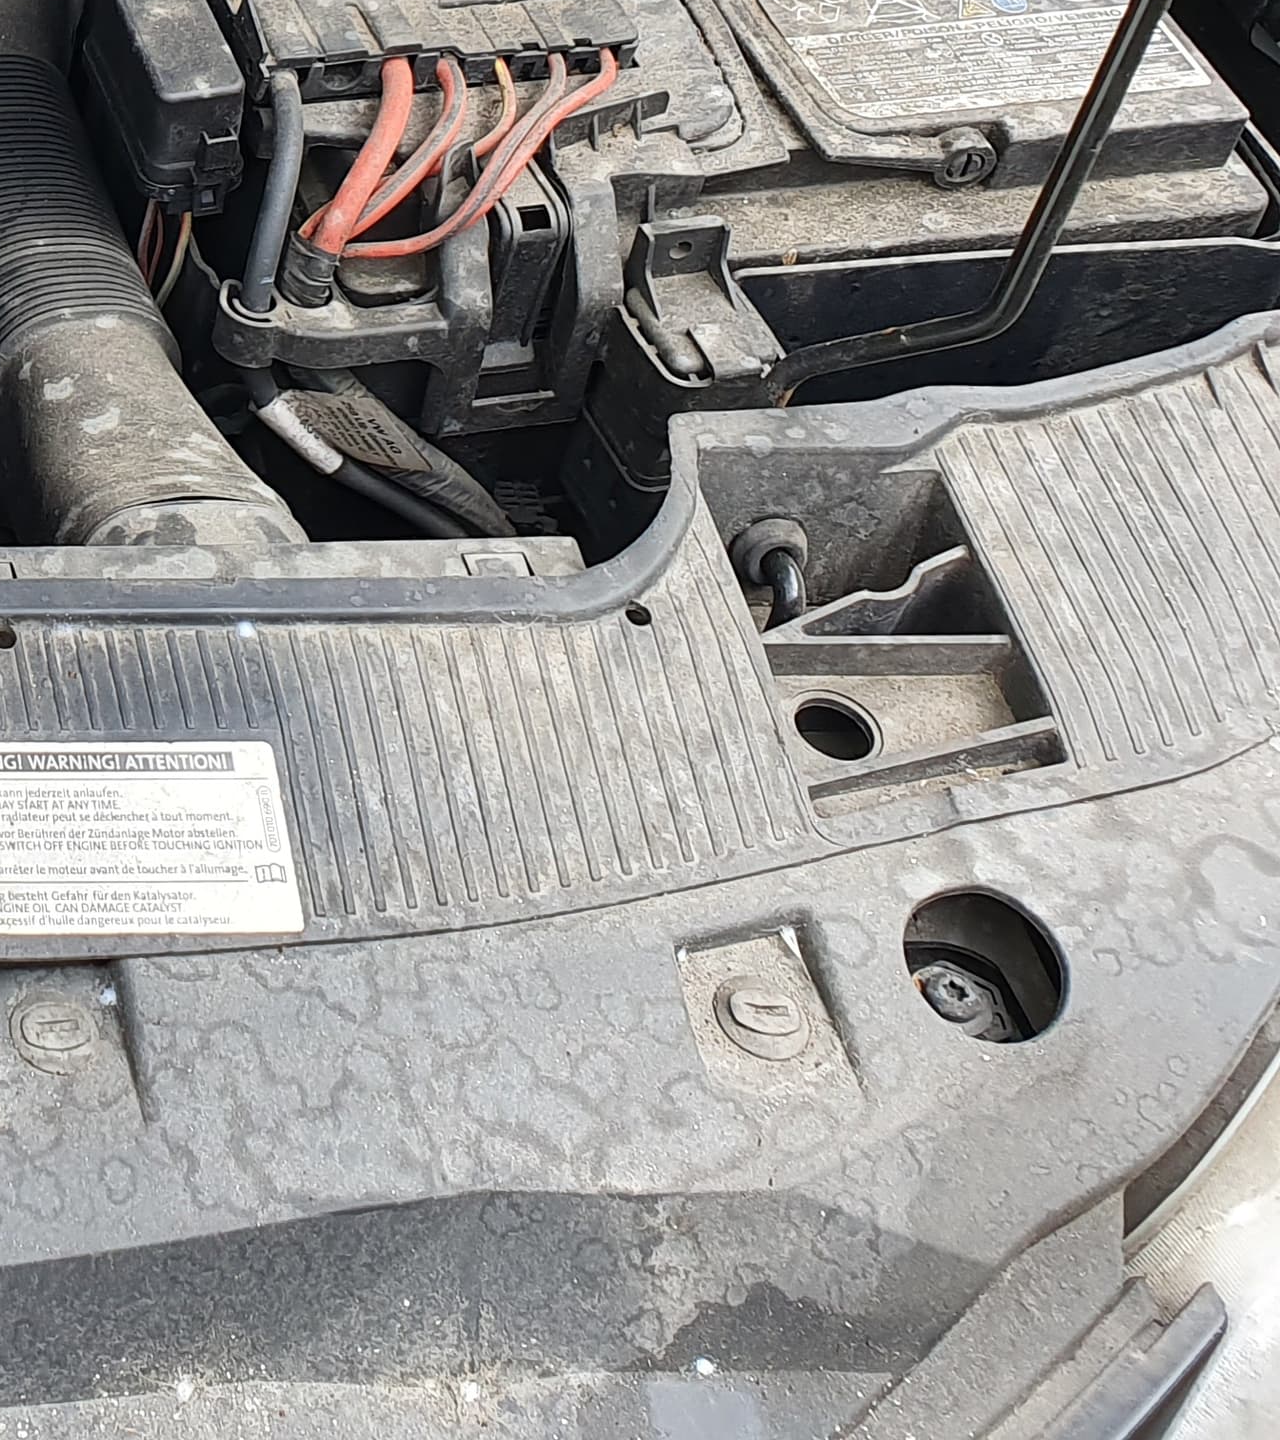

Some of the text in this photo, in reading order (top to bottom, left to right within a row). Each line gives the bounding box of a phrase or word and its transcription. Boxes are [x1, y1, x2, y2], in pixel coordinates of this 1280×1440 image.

[27, 754, 121, 770] WARNING!
[125, 754, 228, 770] ATTENTION!
[25, 787, 71, 801] jederzeit
[74, 788, 123, 798] anlaufen.
[18, 800, 48, 810] START
[51, 800, 64, 810] AT
[68, 800, 90, 810] ANY
[1, 812, 49, 822] radiateur
[52, 813, 77, 824] peut
[80, 814, 91, 822] se
[152, 812, 159, 821] à
[161, 812, 183, 822] tout
[185, 812, 234, 822] moment.
[18, 829, 66, 839] Berühren
[68, 829, 85, 839] der
[88, 829, 150, 841] Zündanlage
[152, 829, 185, 839] Motor
[187, 829, 238, 839] abstellen.
[0, 840, 41, 850] SWITCH
[44, 840, 63, 850] OFF
[66, 840, 108, 850] ENGINE
[110, 840, 150, 850] BEFORE
[152, 840, 211, 850] TOUCHING
[213, 840, 263, 850] IGNITION
[37, 865, 46, 875] le
[48, 866, 88, 875] moteur
[90, 865, 120, 875] avant
[122, 863, 135, 874] de
[137, 863, 178, 874] toucher
[180, 863, 187, 873] à
[8, 891, 48, 901] besteht
[51, 891, 88, 901] Gefahr
[92, 891, 109, 901] für
[111, 891, 131, 901] den
[32, 903, 48, 912] OIL
[55, 903, 79, 912] CAN
[81, 903, 130, 912] DAMAGE
[77, 915, 134, 927] dangereux
[137, 917, 162, 927] pour
[164, 916, 174, 926] le
